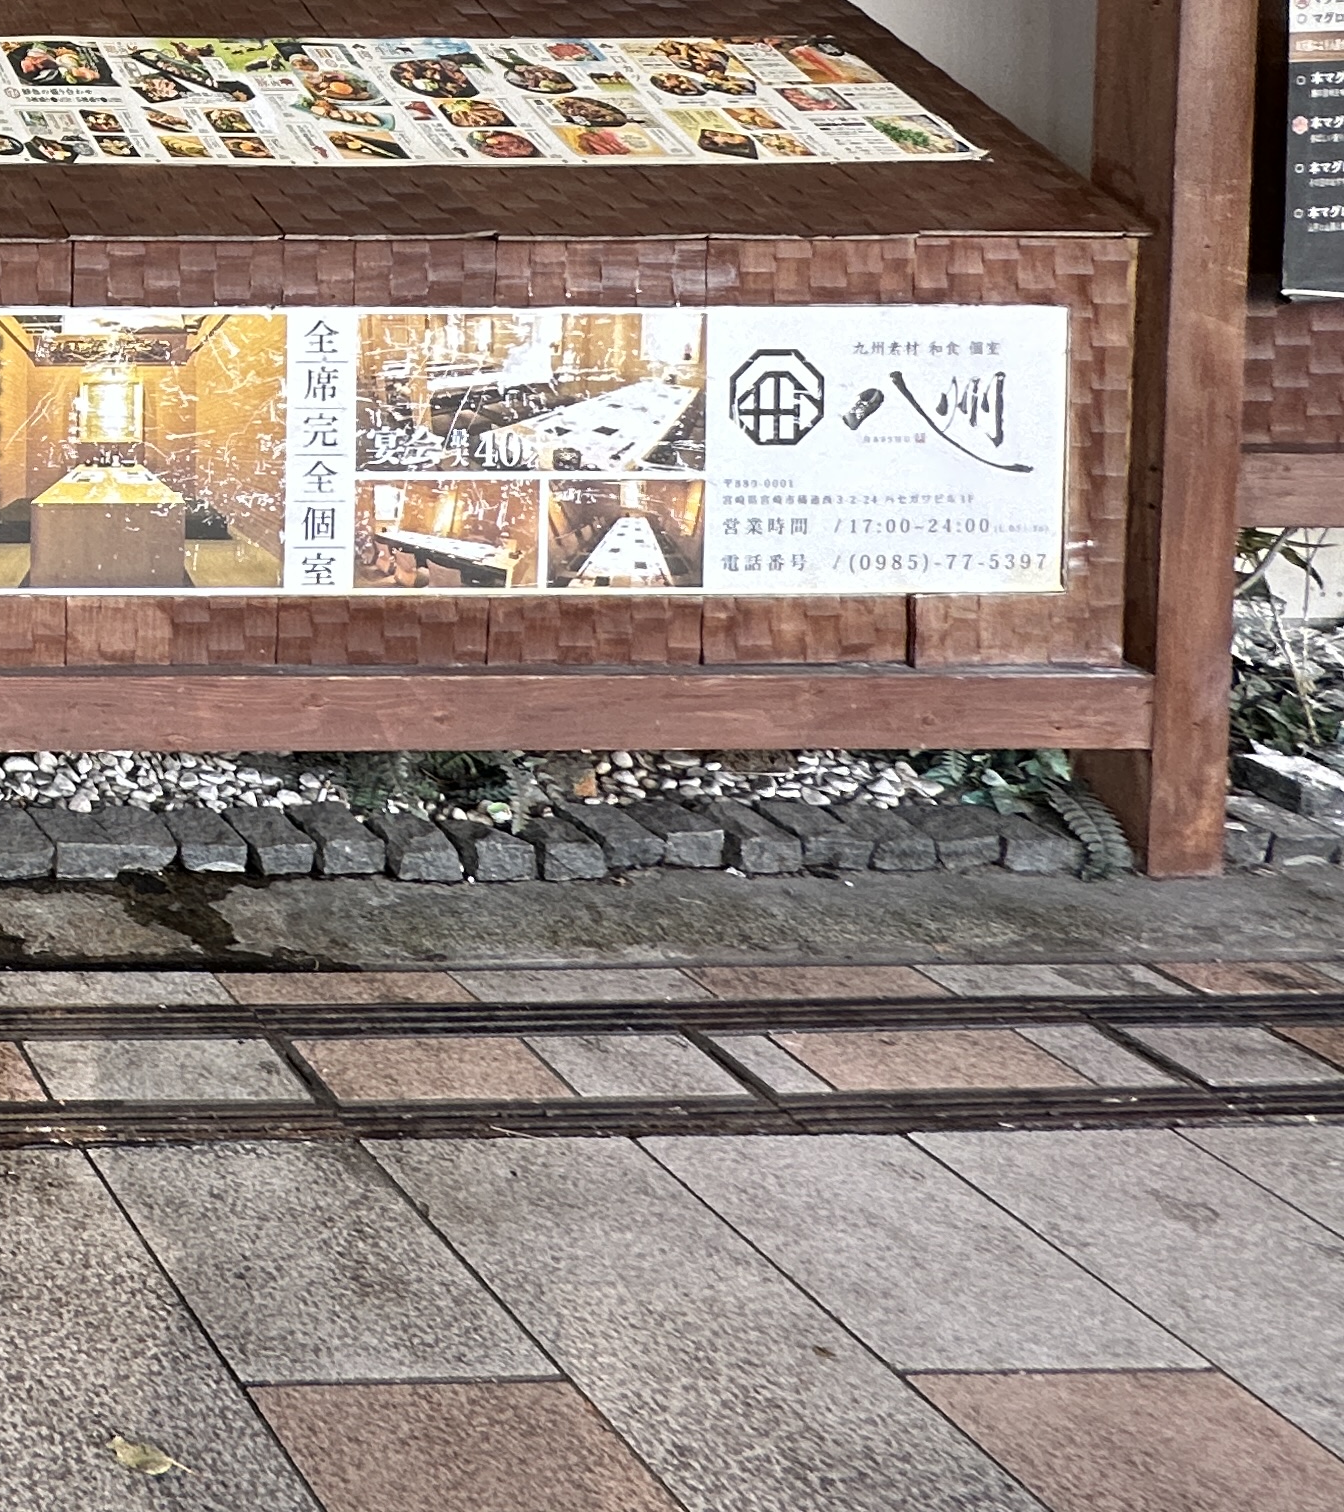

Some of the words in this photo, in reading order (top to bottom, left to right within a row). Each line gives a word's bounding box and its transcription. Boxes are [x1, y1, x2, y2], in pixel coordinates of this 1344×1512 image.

[853, 341, 920, 356] 九州素材
[929, 342, 960, 355] 和食
[970, 342, 1001, 356] 個室
[302, 319, 340, 586] 全席完全個室
[367, 426, 446, 467] 宴会
[722, 518, 809, 535] 営業時間
[721, 554, 808, 572] 電話番号
